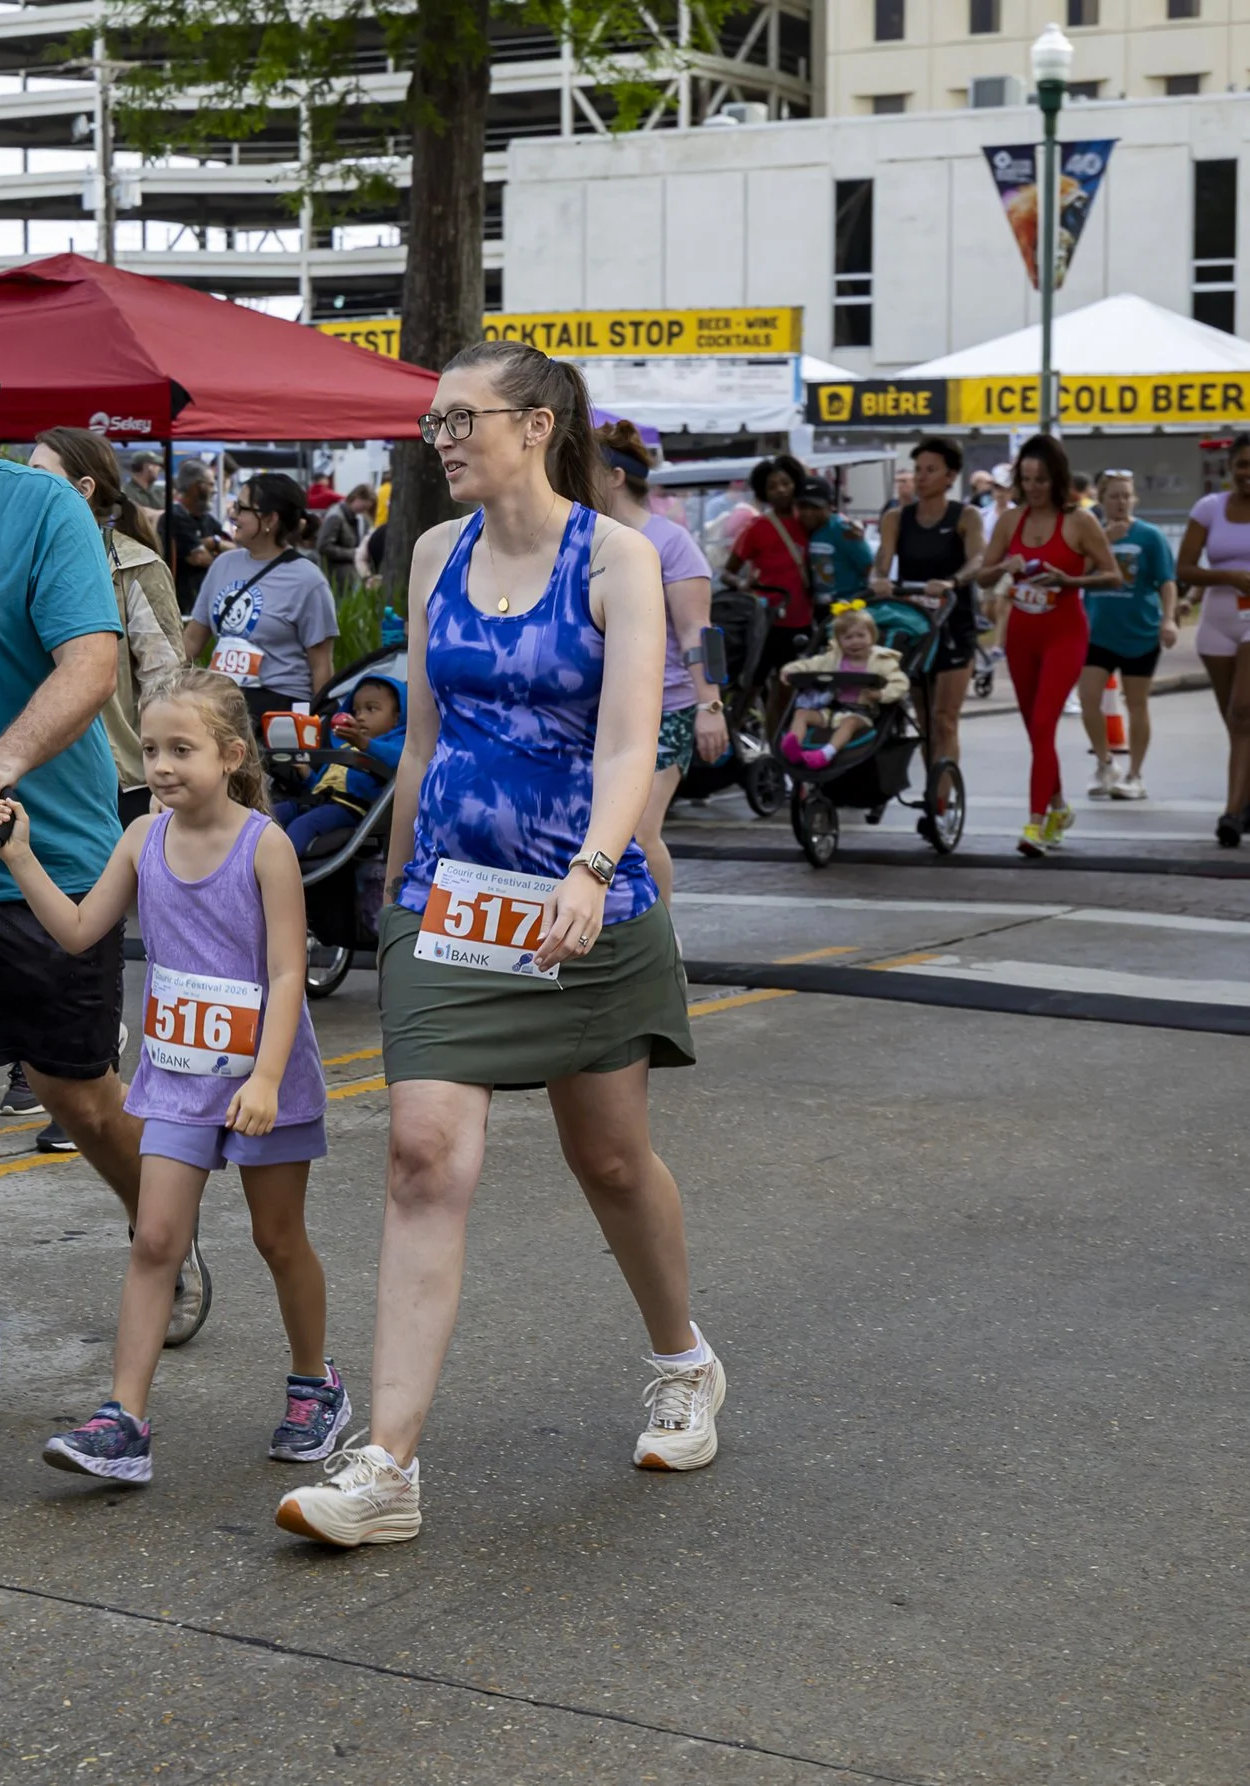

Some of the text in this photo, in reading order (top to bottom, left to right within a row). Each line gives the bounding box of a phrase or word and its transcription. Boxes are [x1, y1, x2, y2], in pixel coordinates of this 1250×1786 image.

[484, 321, 598, 347] OCKTAIL
[609, 319, 684, 347] STOP
[697, 317, 731, 330] BEER
[745, 316, 778, 329] WINE
[696, 334, 772, 347] COCKTAILS
[861, 385, 933, 416] BIÈRE
[984, 386, 1038, 413] ICE
[1152, 383, 1245, 412] BEER
[109, 416, 152, 433] Sekey
[216, 651, 251, 674] 499
[446, 865, 474, 878] Courir
[475, 871, 489, 881] du
[490, 874, 531, 889] Festival
[443, 894, 542, 947] 517
[174, 977, 184, 986] du
[185, 980, 222, 993] Festival
[224, 985, 248, 996] 2026
[155, 1001, 232, 1050] 516
